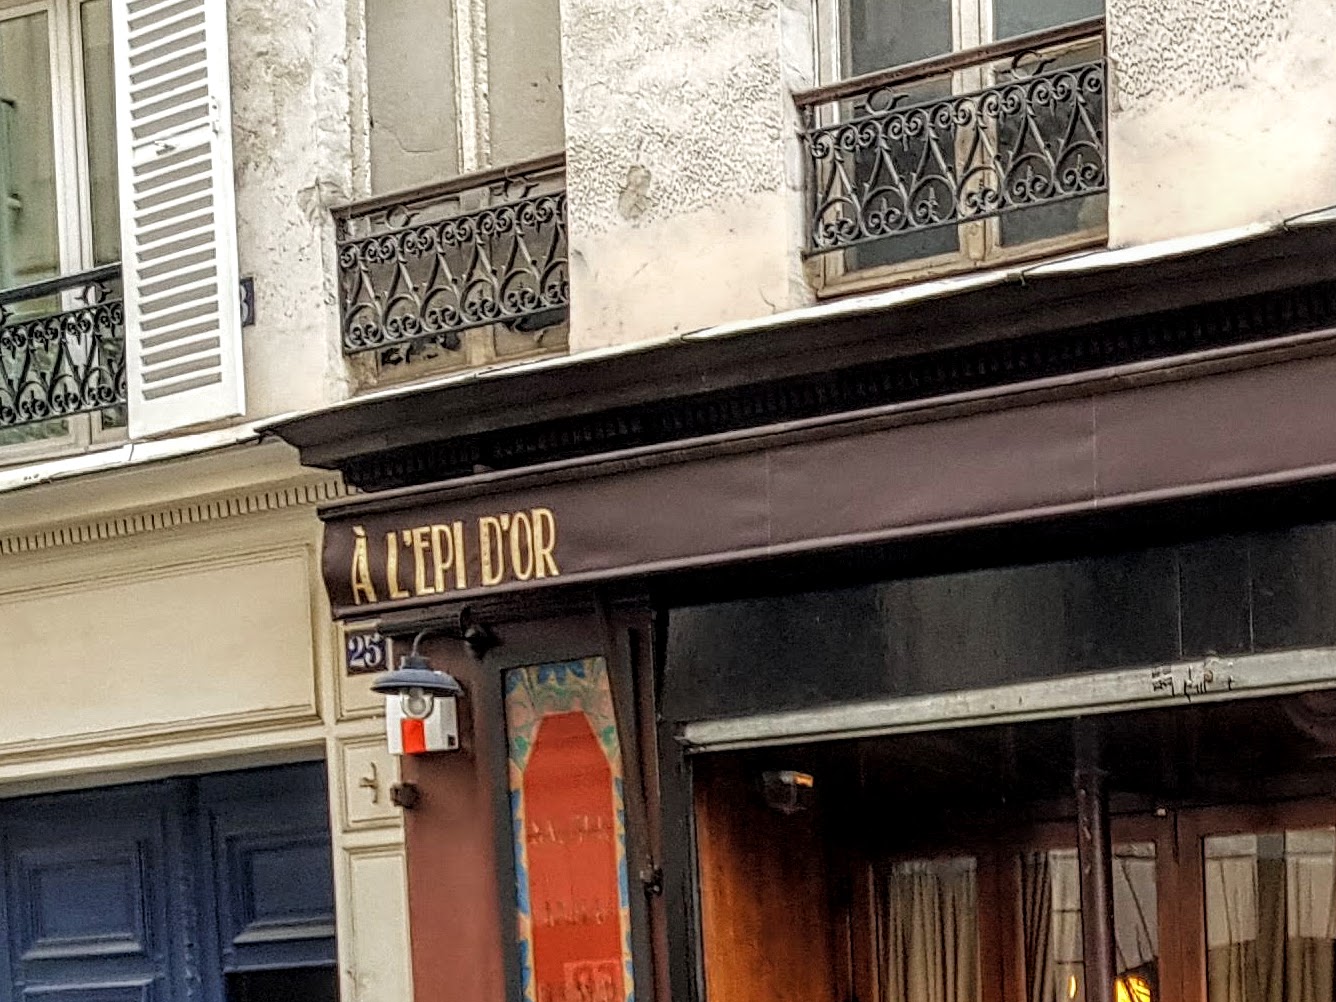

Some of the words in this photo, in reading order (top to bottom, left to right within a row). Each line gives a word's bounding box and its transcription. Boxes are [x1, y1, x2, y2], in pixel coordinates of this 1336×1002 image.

[351, 525, 377, 605] À
[387, 520, 467, 599] L'EPI
[479, 507, 559, 587] D'OR
[348, 632, 382, 667] 25
